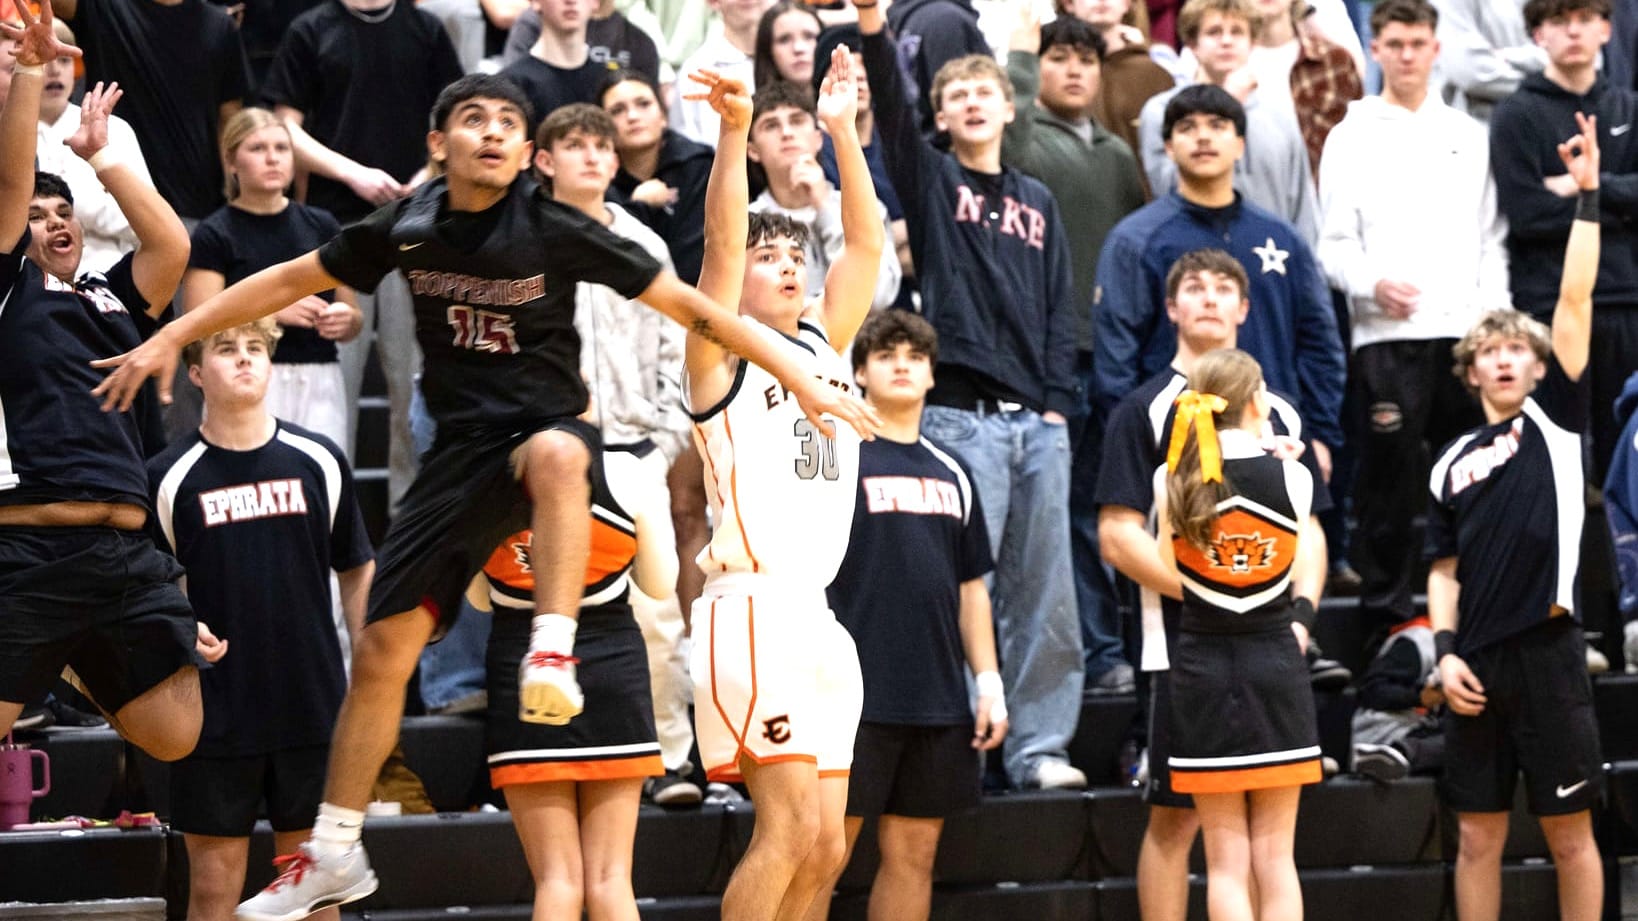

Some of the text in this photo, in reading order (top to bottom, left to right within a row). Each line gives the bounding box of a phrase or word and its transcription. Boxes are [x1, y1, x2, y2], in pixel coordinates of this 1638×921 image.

[955, 184, 1045, 251] NKE
[408, 270, 546, 306] TOPPENISH
[447, 305, 521, 354] 15
[794, 418, 840, 481] 30
[199, 478, 307, 528] EPHRATA
